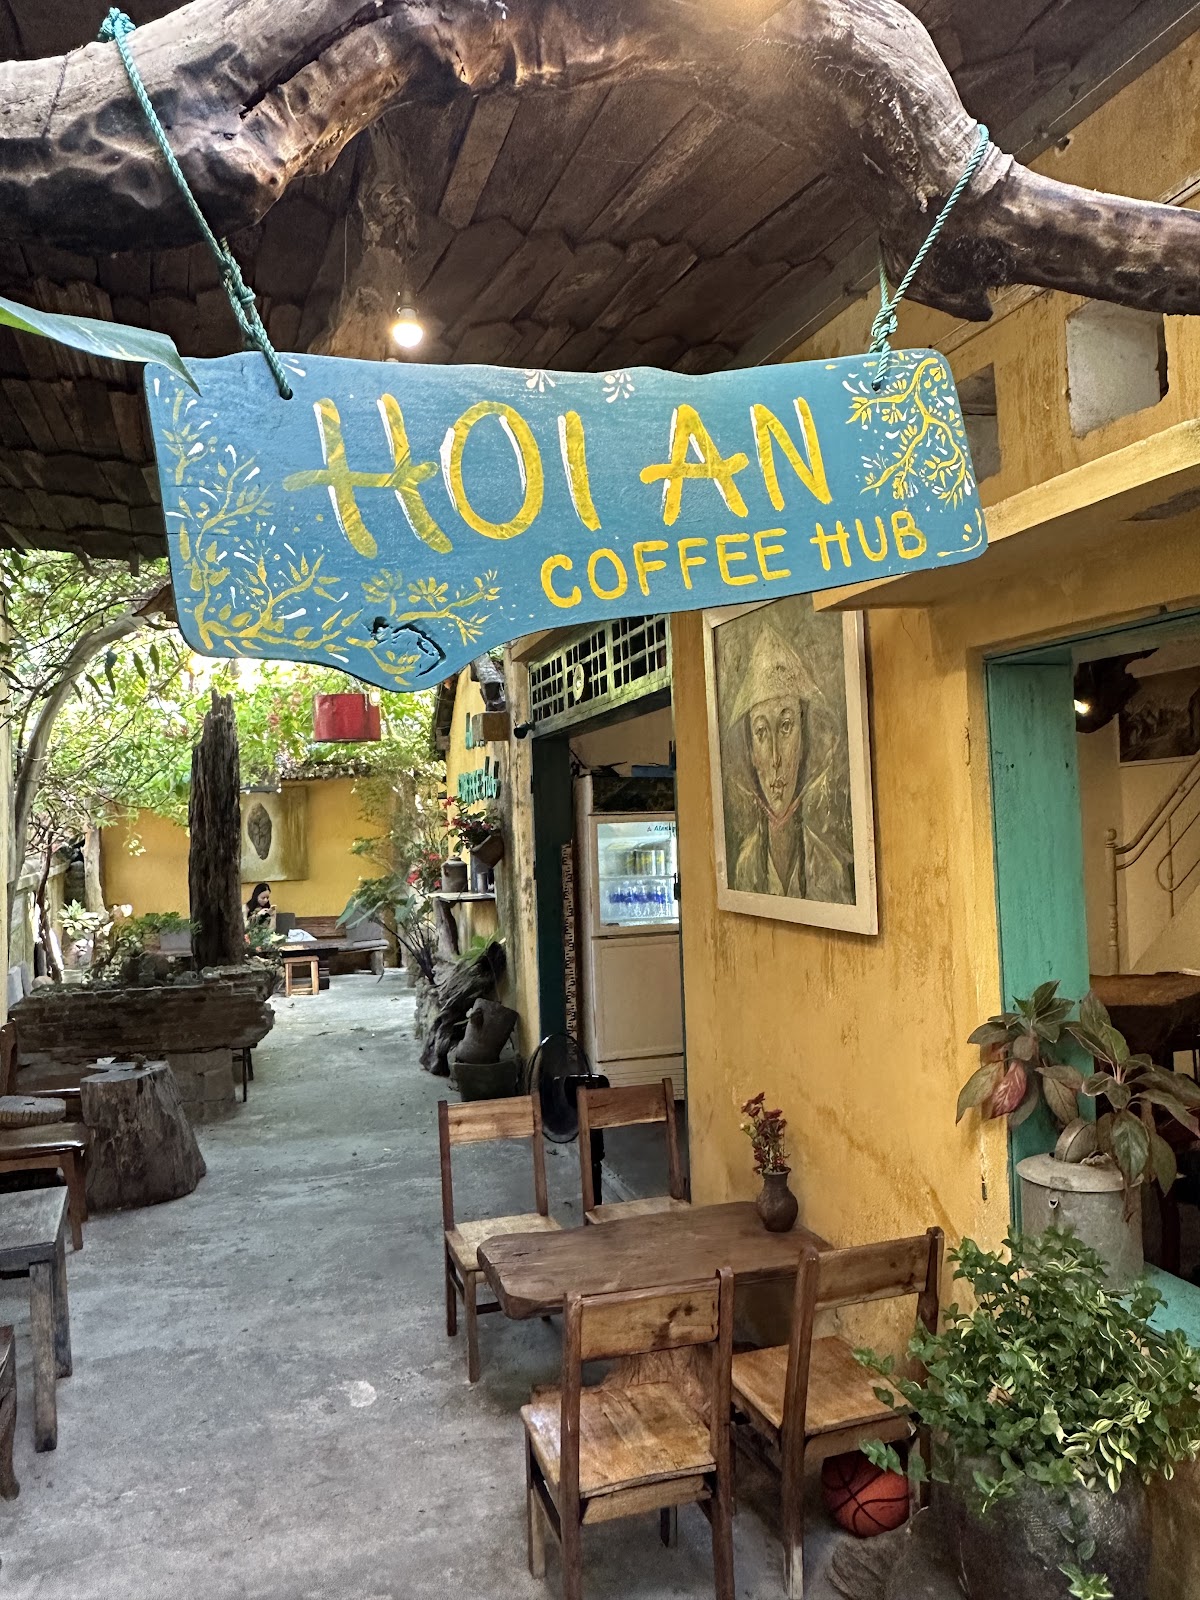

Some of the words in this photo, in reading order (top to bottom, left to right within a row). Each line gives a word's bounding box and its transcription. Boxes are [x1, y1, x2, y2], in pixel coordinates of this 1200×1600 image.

[282, 394, 601, 558] HOI
[638, 397, 833, 526] AN
[540, 528, 791, 609] COFFEE
[809, 510, 928, 571] HUB
